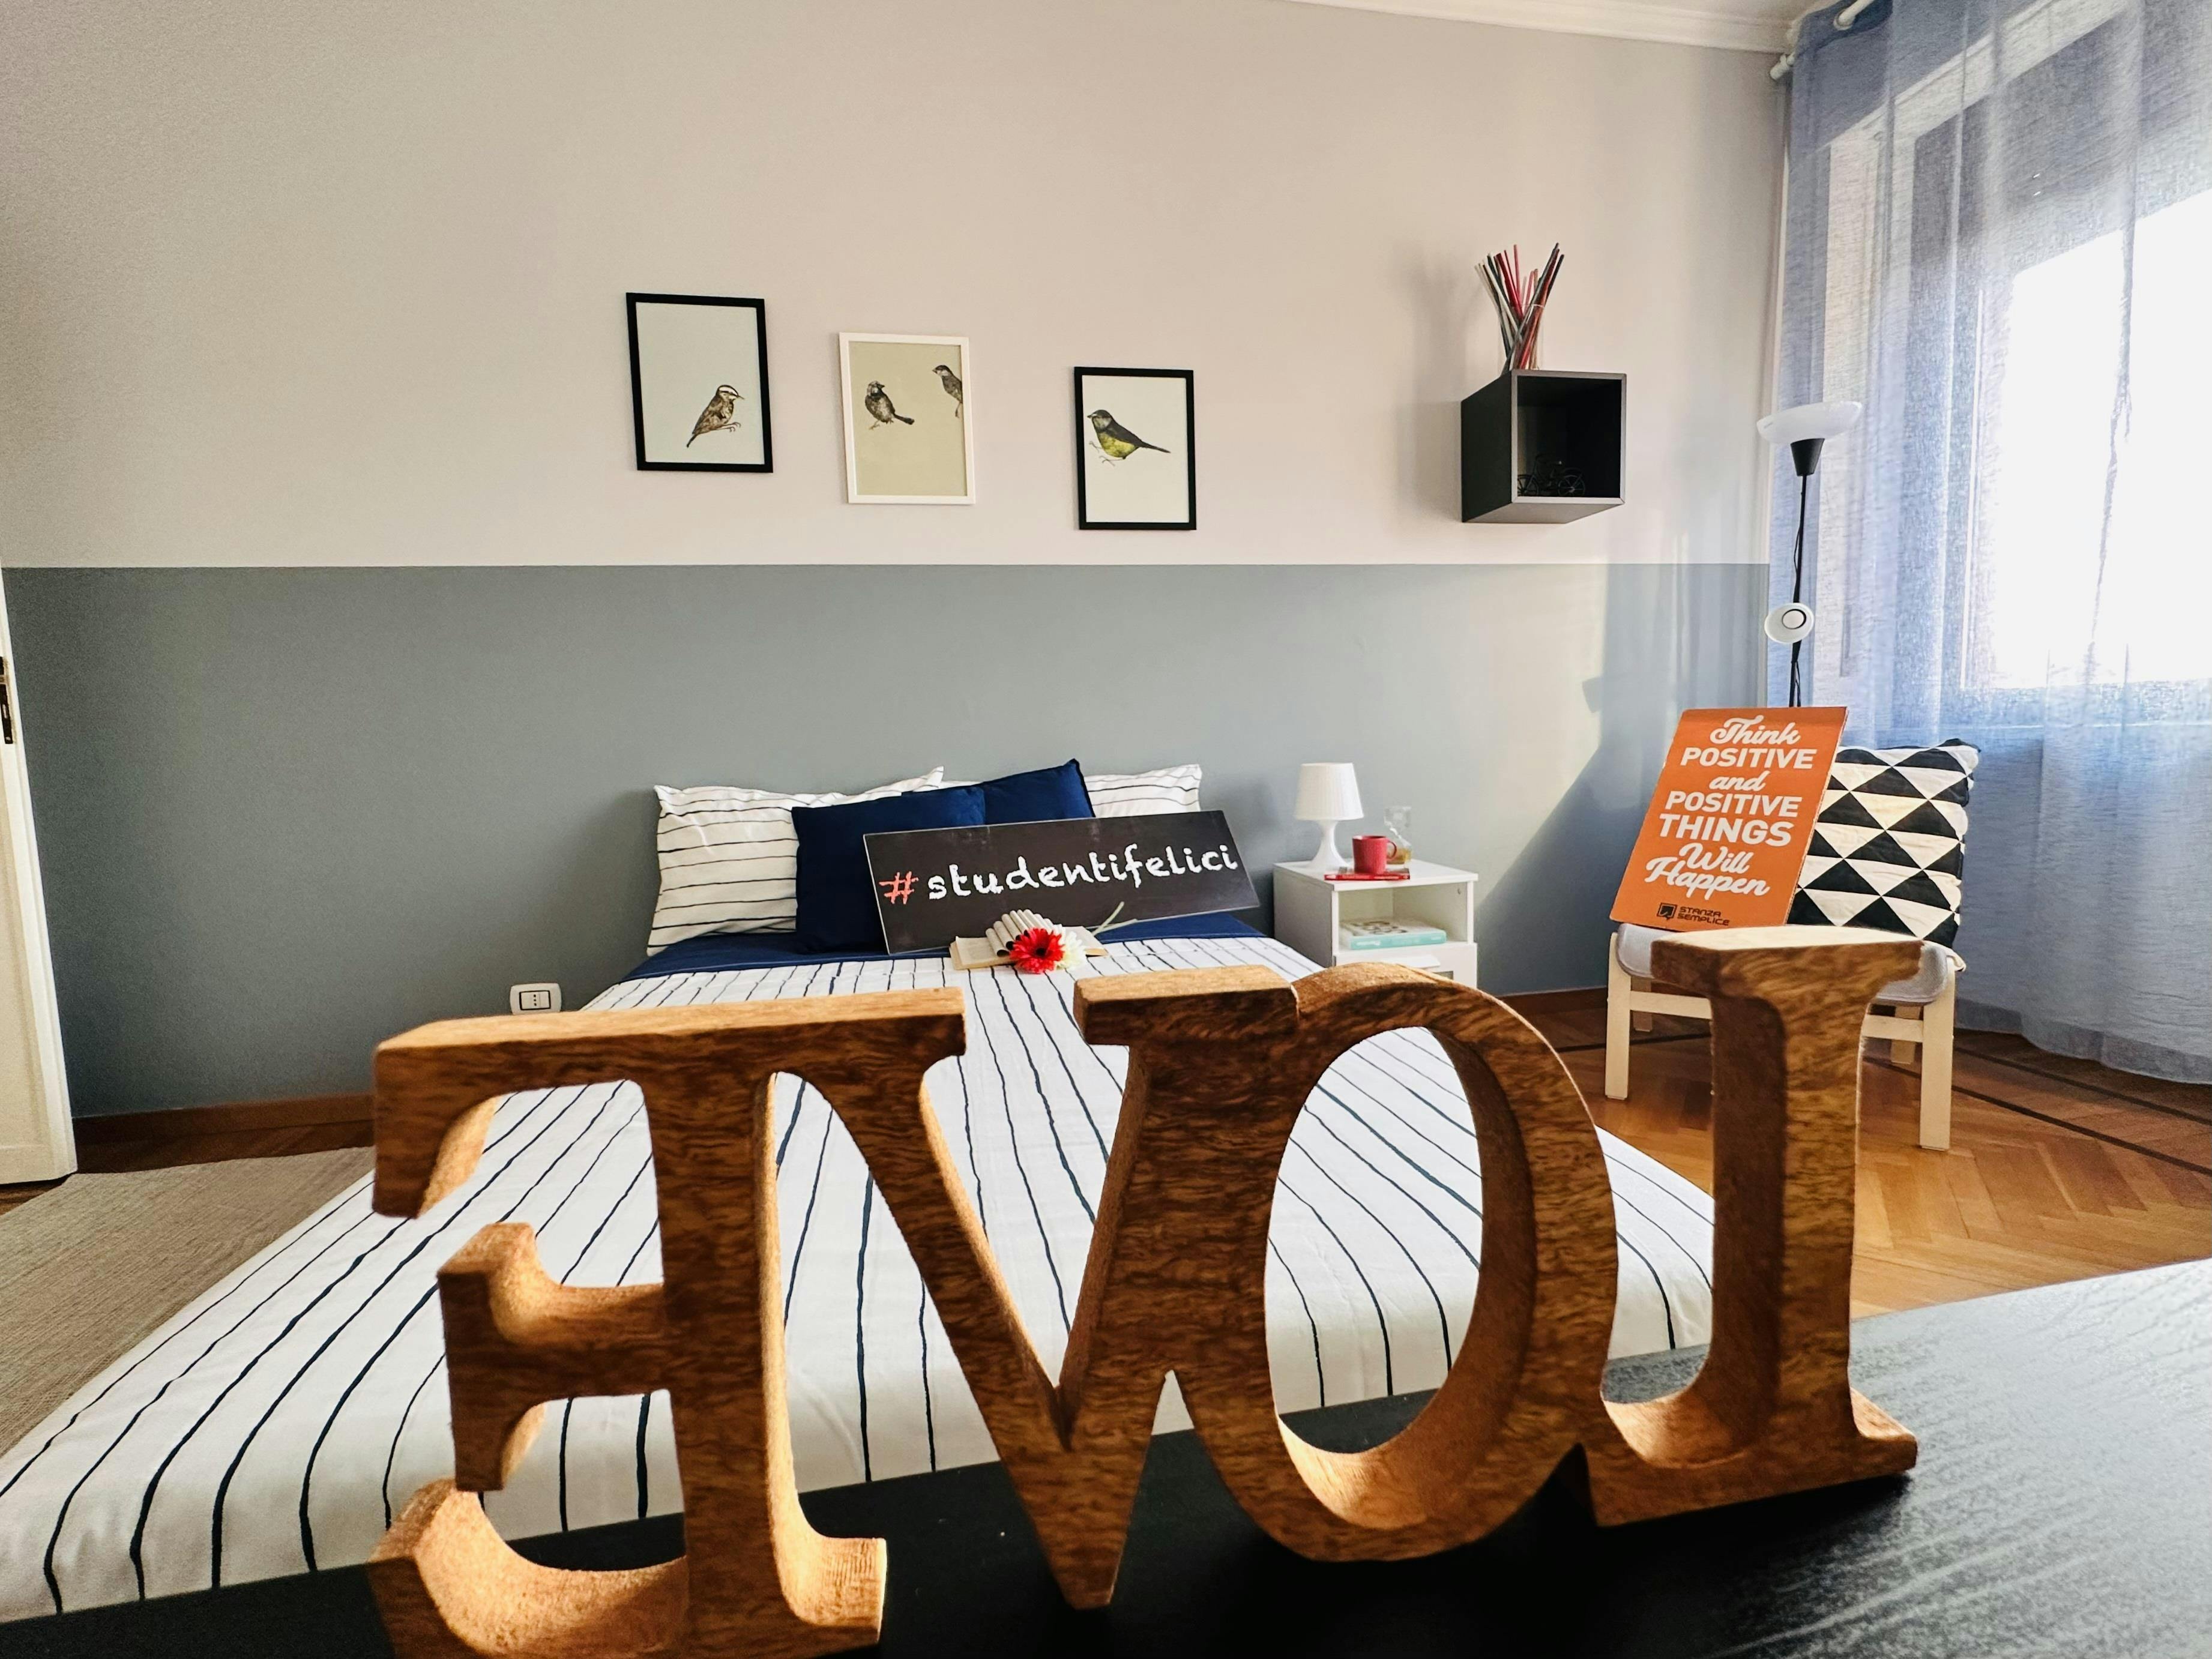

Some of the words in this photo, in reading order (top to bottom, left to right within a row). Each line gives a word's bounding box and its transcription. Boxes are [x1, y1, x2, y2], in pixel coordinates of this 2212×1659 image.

[1710, 714, 1801, 745] Think
[1680, 747, 1818, 769] POSITIVE
[1709, 770, 1771, 792] and
[1665, 790, 1803, 817] POSITIVE
[1659, 813, 1795, 847] THINGS
[878, 843, 1238, 905] #studentifelici
[1678, 842, 1754, 875] Will
[1644, 856, 1771, 900] Happen
